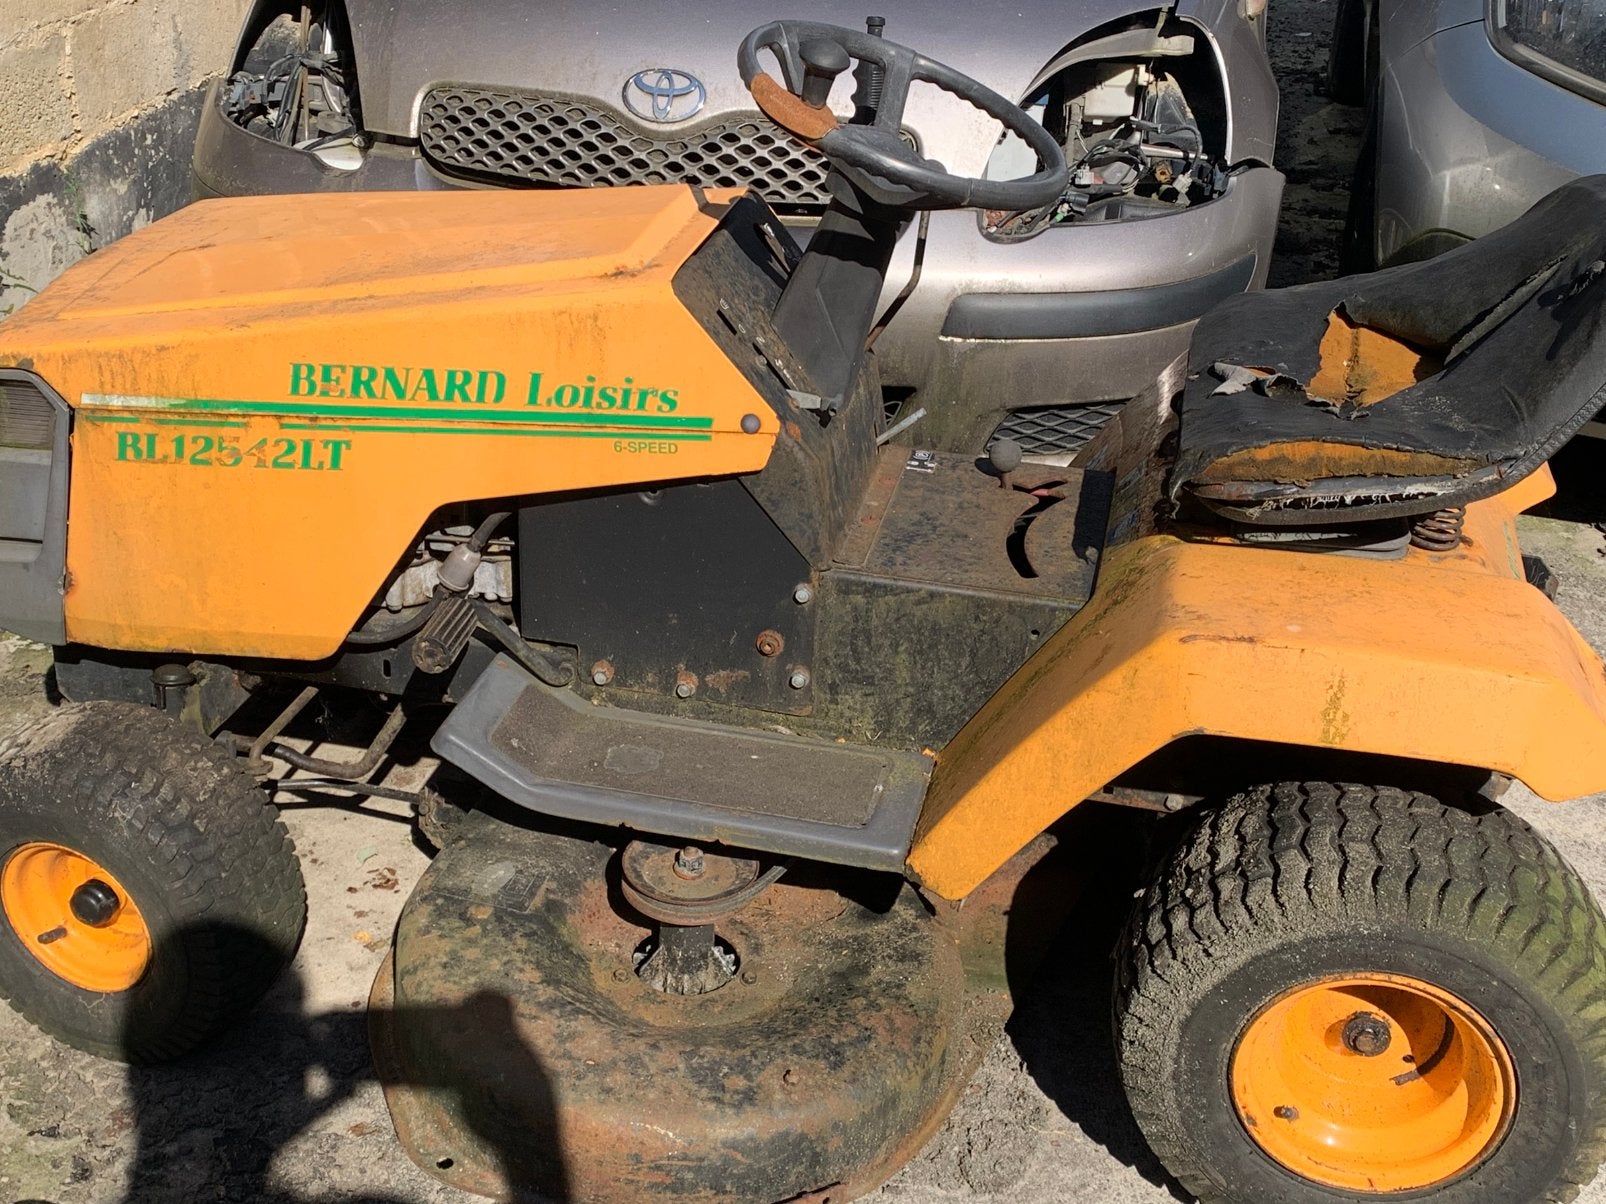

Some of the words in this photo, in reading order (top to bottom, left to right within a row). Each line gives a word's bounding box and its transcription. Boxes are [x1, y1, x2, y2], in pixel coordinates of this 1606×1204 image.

[288, 361, 507, 404] BERNARD
[524, 371, 680, 414] Loisirs
[613, 440, 679, 455] 6-SPEED
